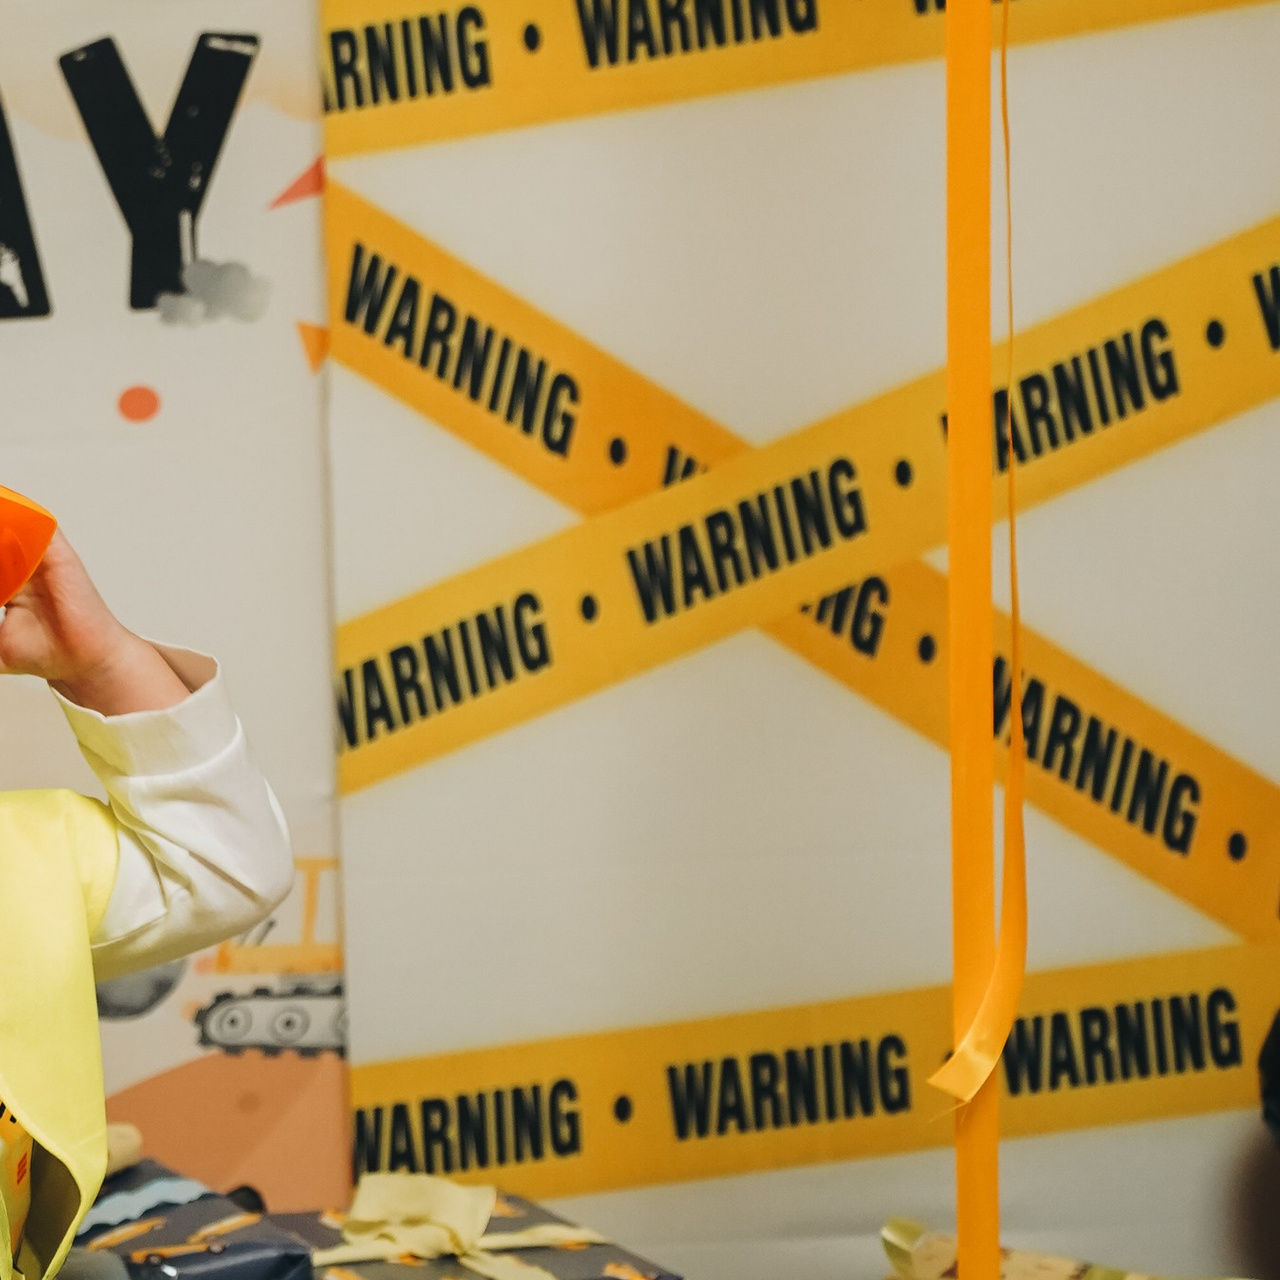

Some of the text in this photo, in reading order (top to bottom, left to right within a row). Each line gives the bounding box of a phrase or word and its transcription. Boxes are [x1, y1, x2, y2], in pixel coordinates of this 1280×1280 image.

[322, 5, 491, 112] RNING
[344, 240, 580, 459] WARNING
[627, 457, 866, 624] WARNING
[941, 317, 1179, 474] ARNING
[667, 1033, 911, 1141] WARNING
[1003, 987, 1242, 1096] WARNING
